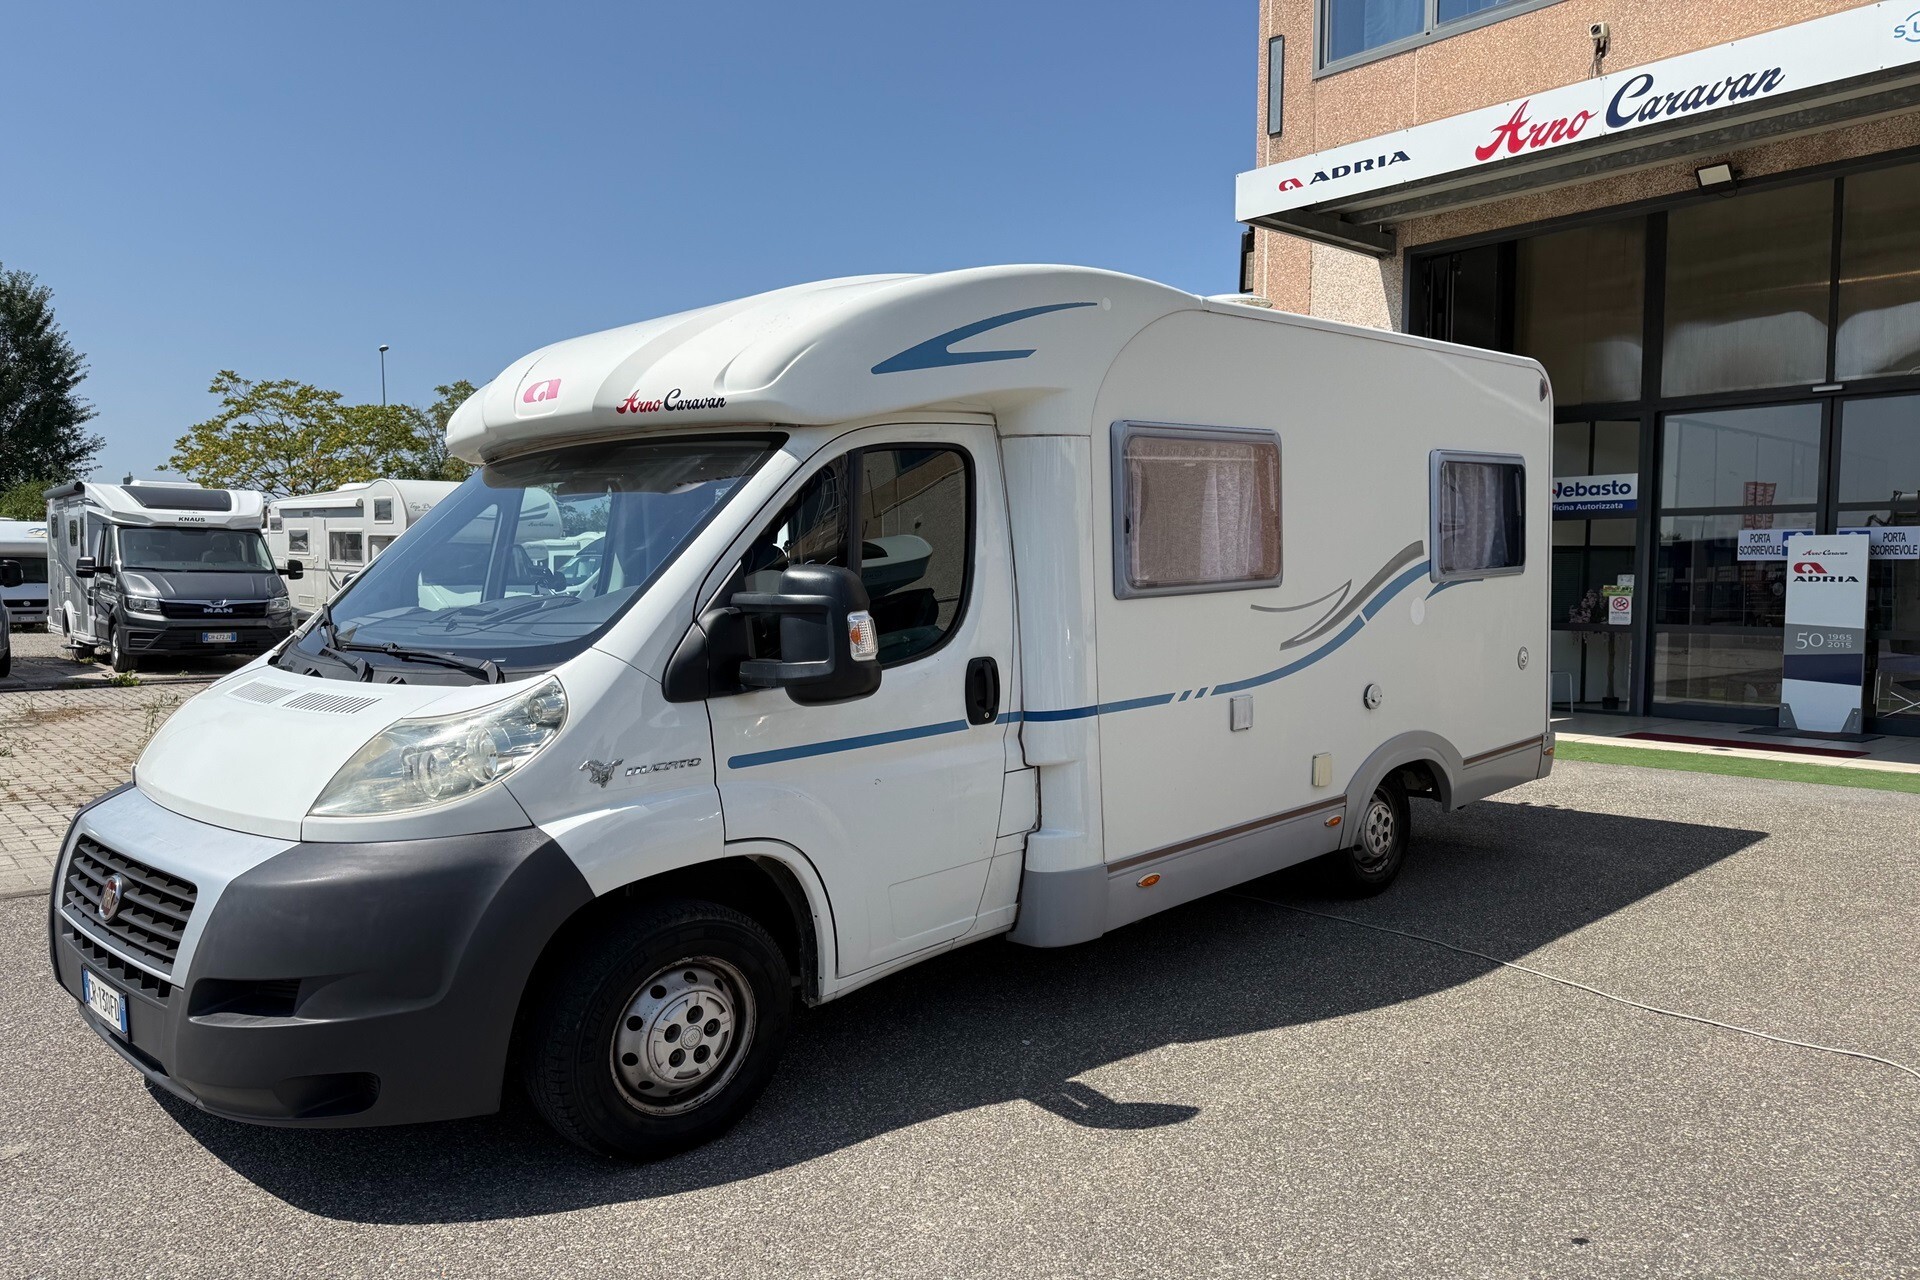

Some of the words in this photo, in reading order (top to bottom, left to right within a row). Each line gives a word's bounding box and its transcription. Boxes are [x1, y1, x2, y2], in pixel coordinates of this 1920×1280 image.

[1475, 99, 1600, 161] Arno
[1605, 66, 1786, 129] Caravan
[1309, 150, 1411, 186] ADRIA
[616, 389, 663, 414] Arno
[663, 388, 727, 411] Caravan
[1575, 502, 1623, 511] Autorizzata
[1750, 533, 1771, 543] PORTA
[1882, 532, 1907, 543] PORTA
[1738, 545, 1782, 556] SCORREVOLE
[1870, 544, 1918, 556] SCORREVOLE
[1795, 631, 1824, 650] 50
[1827, 641, 1852, 649] 2015
